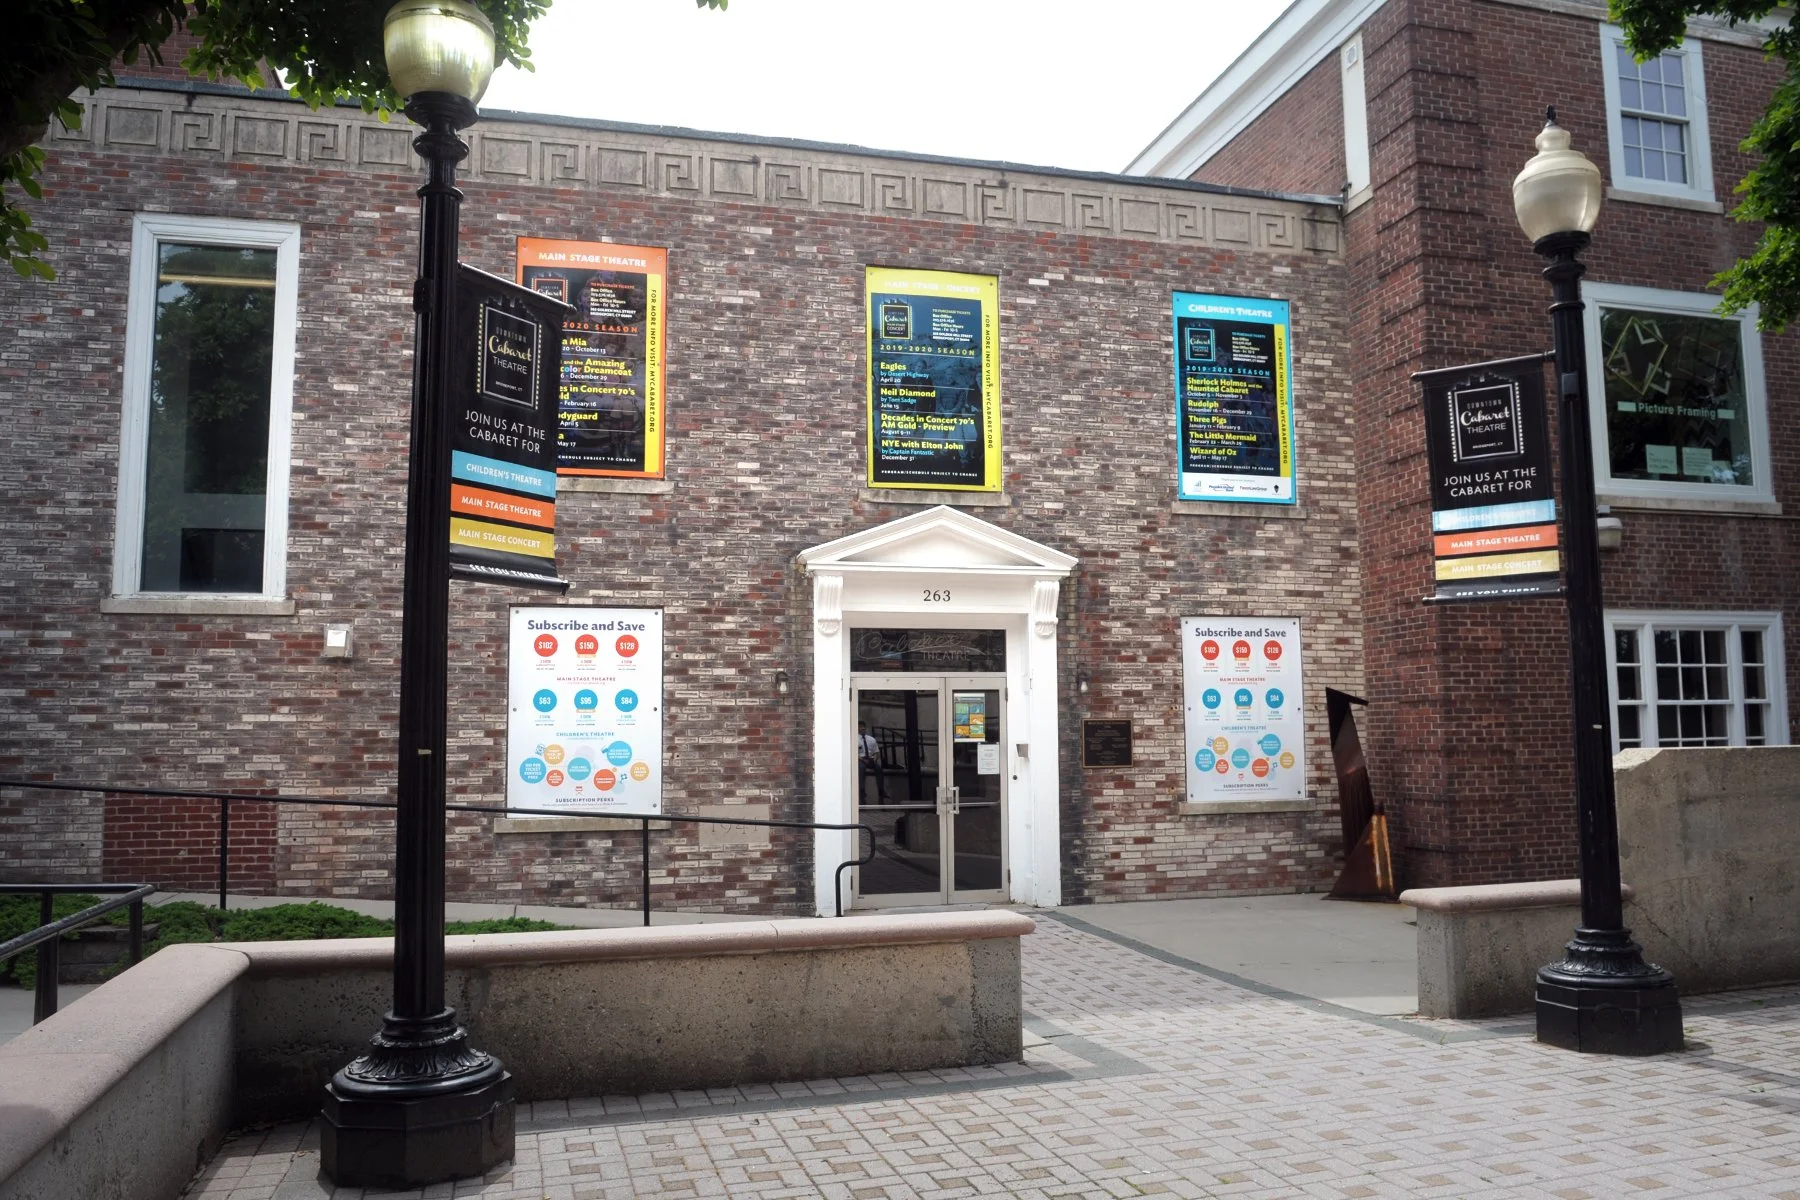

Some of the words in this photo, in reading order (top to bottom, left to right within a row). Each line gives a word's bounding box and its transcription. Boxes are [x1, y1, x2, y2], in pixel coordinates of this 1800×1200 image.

[570, 254, 600, 263] STAGE
[602, 256, 646, 267] THEATRE
[1188, 304, 1234, 314] CHILDREN'S
[1236, 307, 1272, 318] THEATRE
[595, 324, 638, 333] SEASON
[489, 335, 532, 361] Cabaret
[938, 348, 974, 356] SEASON
[493, 356, 527, 374] THEATRE
[585, 358, 625, 369] Amazing
[881, 362, 907, 371] Eagles
[584, 366, 632, 376] Dreamcoat
[1187, 377, 1219, 386] Sherlock
[580, 385, 616, 394] Concert
[618, 387, 635, 395] 70's
[899, 389, 935, 397] Diamond
[1221, 386, 1249, 394] Cabaret
[1188, 400, 1219, 408] Rudolph
[558, 412, 598, 421] dyguard
[1460, 406, 1510, 426] Cabaret
[1638, 404, 1674, 415] Picture
[1676, 406, 1716, 419] Framing
[881, 414, 914, 422] Decades
[926, 416, 957, 424] Concert
[1212, 416, 1227, 424] Pigs
[465, 410, 490, 426] JOIN
[494, 417, 507, 430] US
[511, 422, 524, 434] AT
[528, 425, 545, 440] THE
[923, 423, 955, 431] Preview
[1467, 423, 1506, 434] THEATRE
[470, 426, 518, 448] CABARET
[522, 439, 540, 453] FOR
[467, 463, 509, 480] CHILDREN'S
[511, 473, 542, 486] THEATRE
[1444, 474, 1471, 487] JOIN
[1476, 472, 1490, 482] US
[1494, 470, 1509, 480] AT
[1513, 467, 1536, 478] THE
[1451, 483, 1504, 497] CABARET
[1508, 480, 1532, 491] FOR
[461, 496, 483, 507] MAIN
[485, 500, 508, 512] STAGE
[510, 504, 542, 518] THEATRE
[458, 528, 480, 539] MAIN
[483, 532, 506, 543] STAGE
[508, 535, 540, 548] CONCERT
[1476, 538, 1501, 546] STAGE
[1502, 534, 1540, 544] THEATRE
[1504, 560, 1542, 569] CONCERT
[923, 590, 951, 601] 263
[528, 620, 589, 631] Subscribe
[592, 621, 614, 631] and
[617, 621, 645, 631] Save
[1195, 628, 1242, 637] Subscribe
[1244, 628, 1262, 637] and
[1264, 628, 1286, 637] Save
[538, 641, 553, 649] $102
[580, 642, 594, 650] $150
